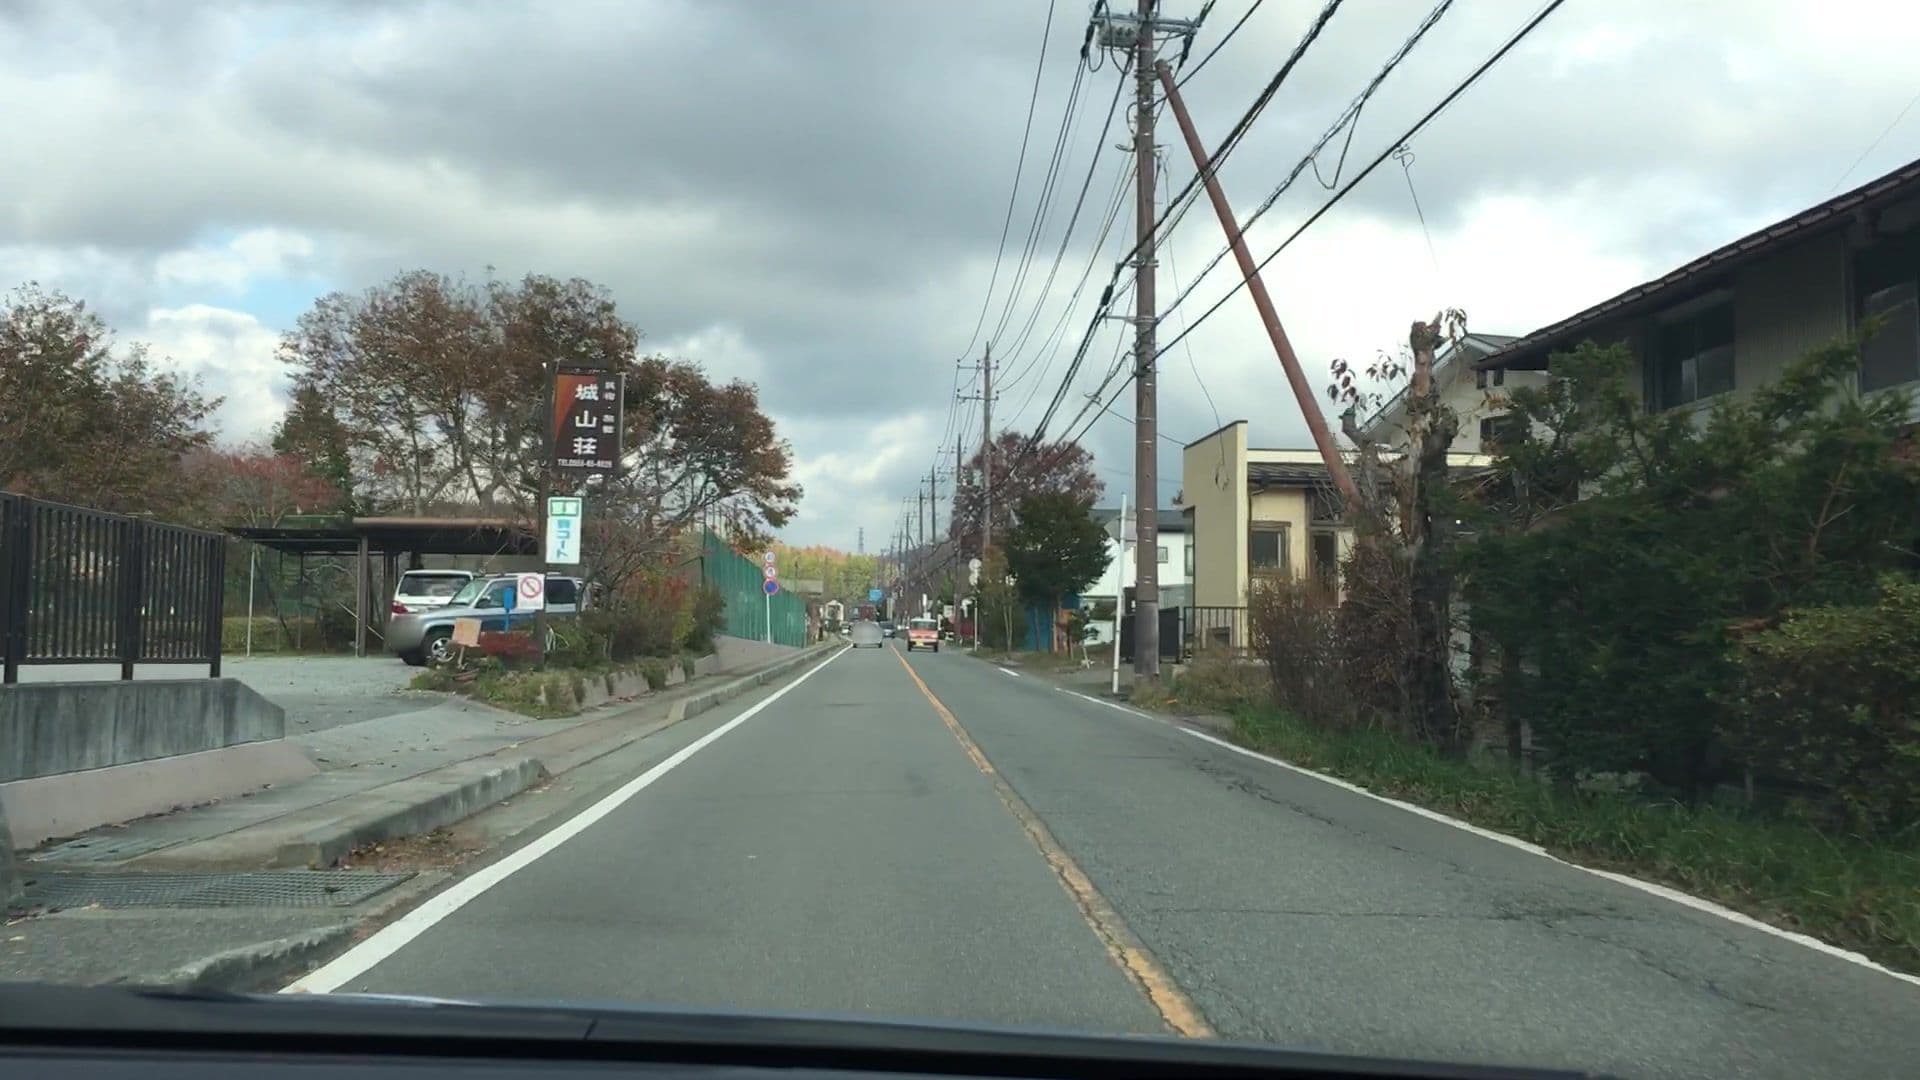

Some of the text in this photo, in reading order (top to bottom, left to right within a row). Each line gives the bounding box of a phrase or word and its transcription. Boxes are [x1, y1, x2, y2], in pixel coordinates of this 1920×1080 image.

[573, 384, 599, 455] 城山荘
[556, 519, 570, 559] コート
